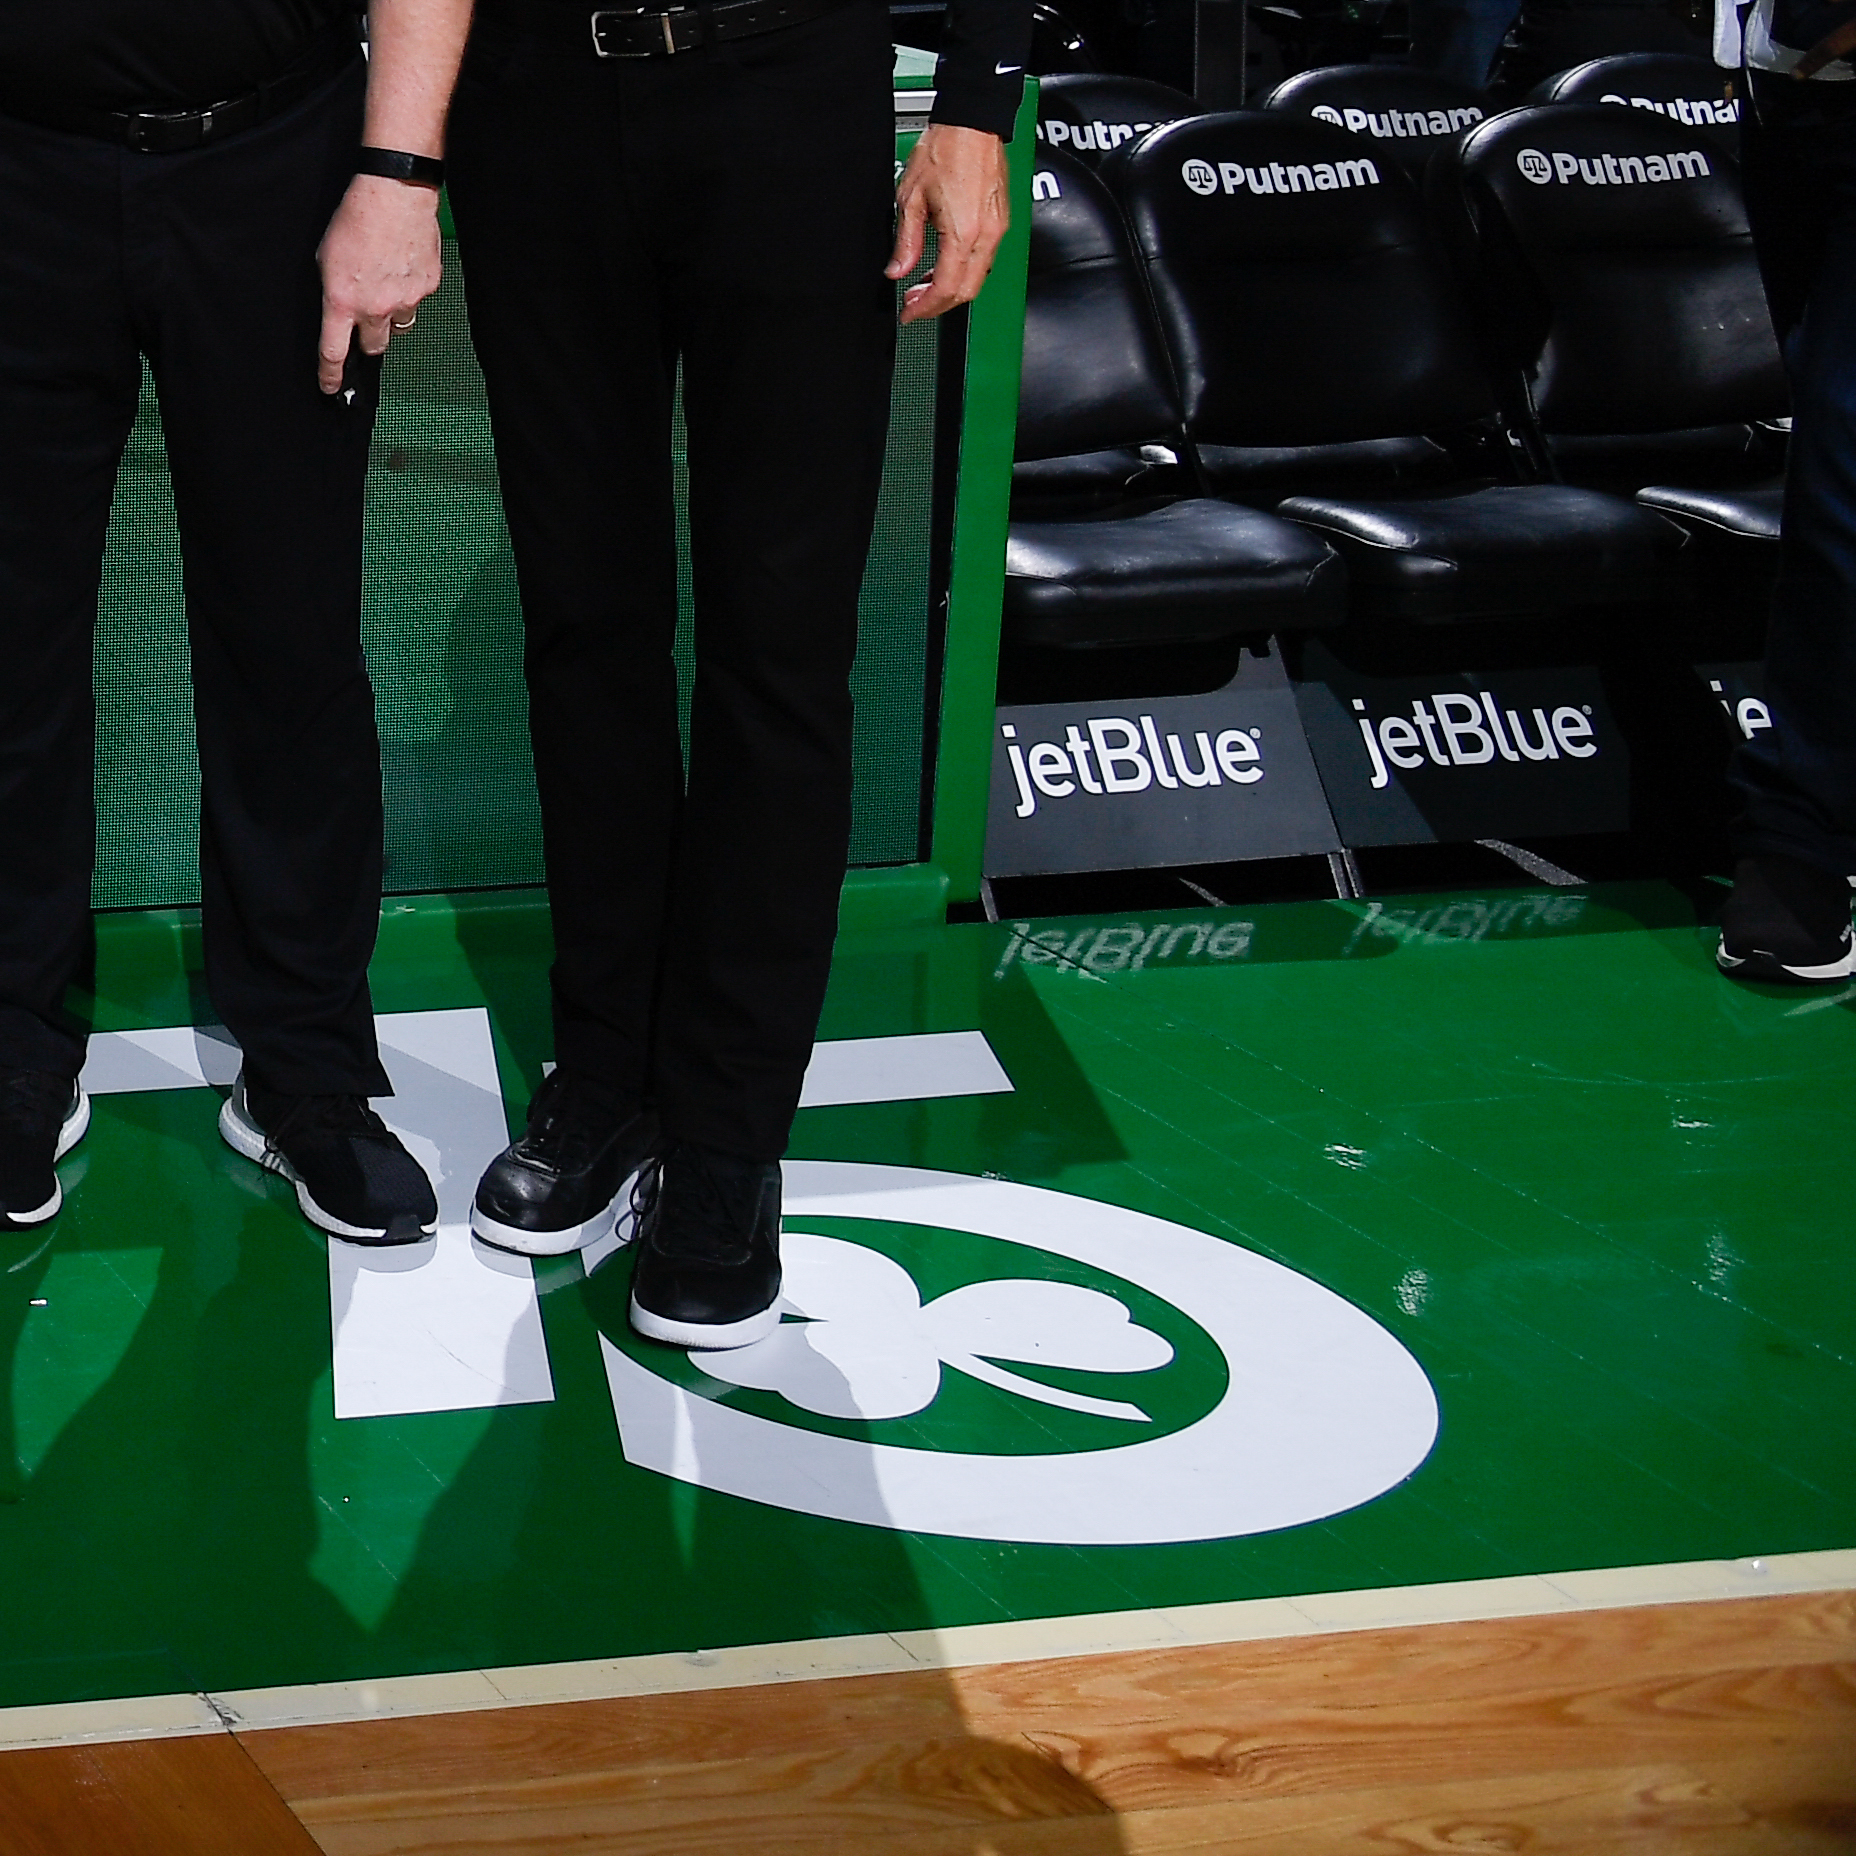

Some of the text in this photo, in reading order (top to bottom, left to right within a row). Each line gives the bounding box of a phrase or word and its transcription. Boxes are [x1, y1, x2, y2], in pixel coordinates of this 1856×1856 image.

[1344, 105, 1485, 141] Putnam
[1222, 154, 1381, 196] Putnam
[1553, 147, 1711, 187] Putnam
[1351, 692, 1598, 790] jetBlue
[1001, 714, 1266, 818] jetBlue
